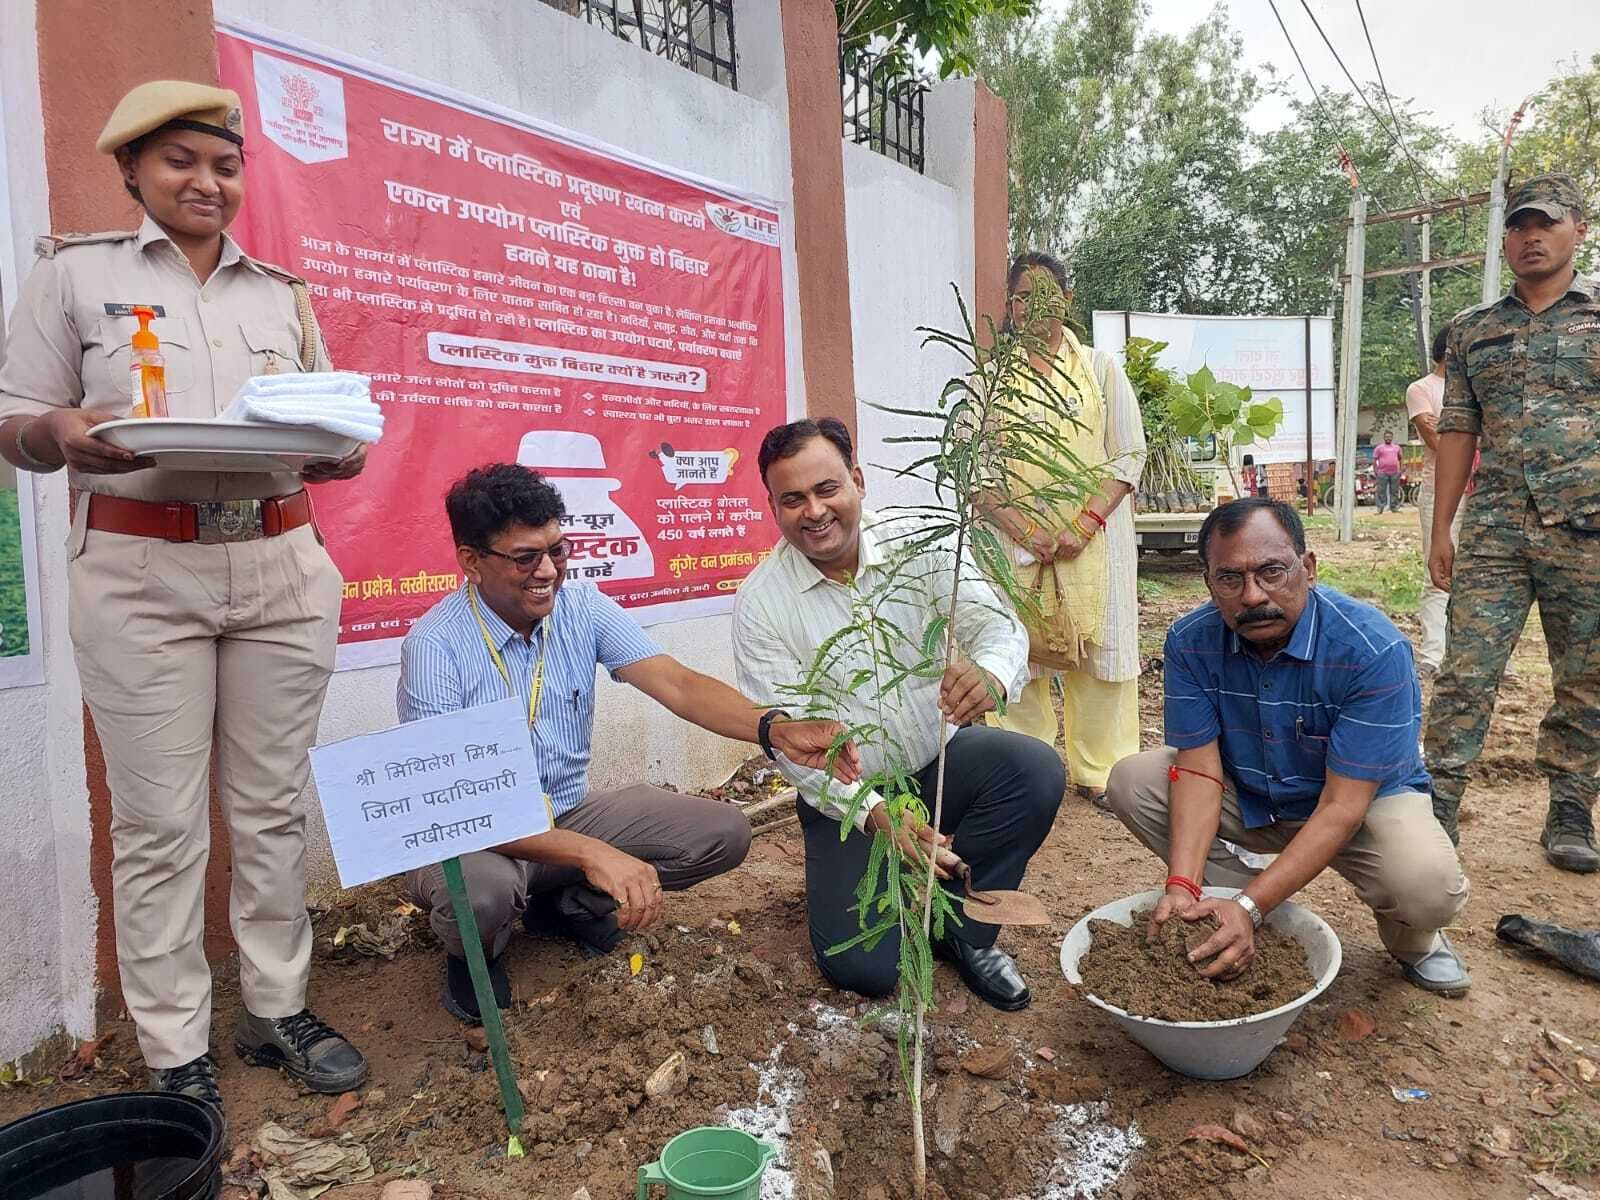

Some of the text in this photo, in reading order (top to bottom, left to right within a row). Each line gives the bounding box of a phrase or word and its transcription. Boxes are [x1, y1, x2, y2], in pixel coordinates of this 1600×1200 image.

[380, 118, 706, 231] राज्य में प्लास्टिक प्रदूषण खत्म करने
[560, 201, 581, 221] एवं
[384, 180, 709, 276] एकल उपयोग प्लास्टिक मुक्त हो बिहार
[744, 216, 777, 235] LiFE
[300, 236, 331, 252] आज
[335, 241, 350, 256] के
[353, 247, 394, 264] समय
[396, 254, 411, 267] में
[414, 257, 470, 279] प्लास्टिक
[473, 270, 505, 286] हमारे
[507, 275, 540, 291] जीवन
[543, 283, 557, 295] का
[559, 286, 576, 298] एक
[504, 244, 636, 287] हमने यह ठाना है!
[300, 257, 348, 277] उपयोग
[353, 267, 393, 284] हमारे
[396, 274, 452, 294] पर्यावरण
[456, 283, 469, 297] के
[473, 287, 498, 302] लिए
[502, 295, 534, 308] घातक
[538, 301, 569, 314] साबित
[572, 305, 583, 317] हो
[586, 309, 603, 321] रहा
[332, 287, 352, 301] भी
[355, 292, 417, 311] प्लास्टिक
[419, 300, 434, 314] से
[436, 303, 477, 321] प्रदूषित
[478, 309, 491, 323] हो
[495, 312, 516, 327] रही
[533, 318, 588, 337] प्लास्टिक
[591, 327, 607, 340] का
[608, 329, 645, 347] उपयोग
[677, 340, 718, 358] पर्यावरण
[438, 343, 520, 364] प्लास्टिक
[523, 353, 559, 369] मुक्त
[561, 356, 604, 374] बिहार
[607, 363, 635, 378] क्यों
[636, 366, 646, 379] है
[368, 371, 401, 384] मारे
[404, 375, 431, 387] जल
[468, 379, 487, 391] को
[489, 382, 518, 395] दूषित
[521, 385, 551, 397] करता
[553, 387, 561, 398] है
[375, 390, 562, 414] की उर्वरता शक्ति को कम करता है
[639, 412, 652, 421] पर
[653, 412, 665, 422] भी
[676, 455, 719, 469] क्या आप
[677, 467, 720, 479] जानते हैं
[656, 494, 750, 509] प्लास्टिक बोतल
[656, 507, 763, 525] को गलने में करीब
[657, 525, 747, 541] 450 वर्ष लगते हैं
[582, 562, 615, 578] कहें
[669, 554, 698, 577] मुंगेर
[701, 556, 718, 569] वन
[400, 570, 458, 594] लखीसराय
[355, 769, 375, 788] श्री
[385, 752, 456, 782] मिथिलेश
[361, 769, 518, 823] जिला पदाधिकारी
[401, 813, 493, 849] लखीसराय
